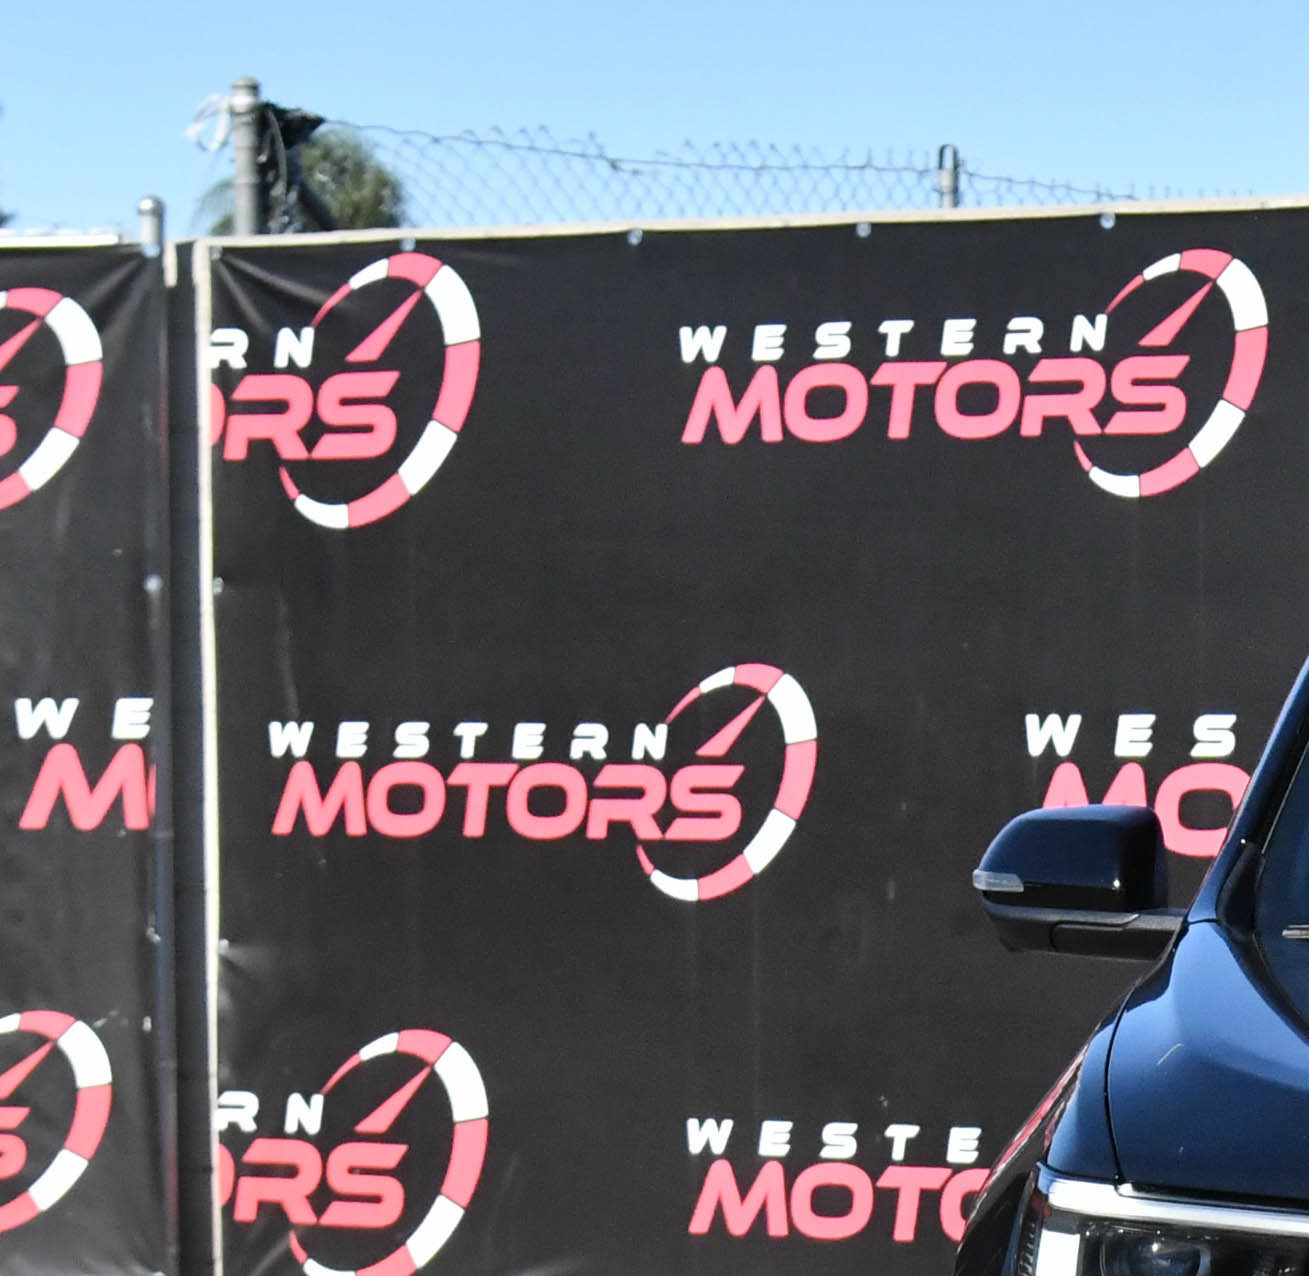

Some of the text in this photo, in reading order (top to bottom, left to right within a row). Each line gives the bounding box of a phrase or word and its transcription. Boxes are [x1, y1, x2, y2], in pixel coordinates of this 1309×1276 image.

[679, 314, 1108, 364] WESTERN
[211, 370, 400, 461] RS
[681, 354, 1191, 444] MOTORS
[268, 721, 668, 760] WESTERN
[1025, 713, 1238, 759] WES
[19, 743, 157, 831] M
[271, 760, 745, 841] MOTORS
[686, 1118, 983, 1165] WESTE
[218, 1138, 408, 1229] RS
